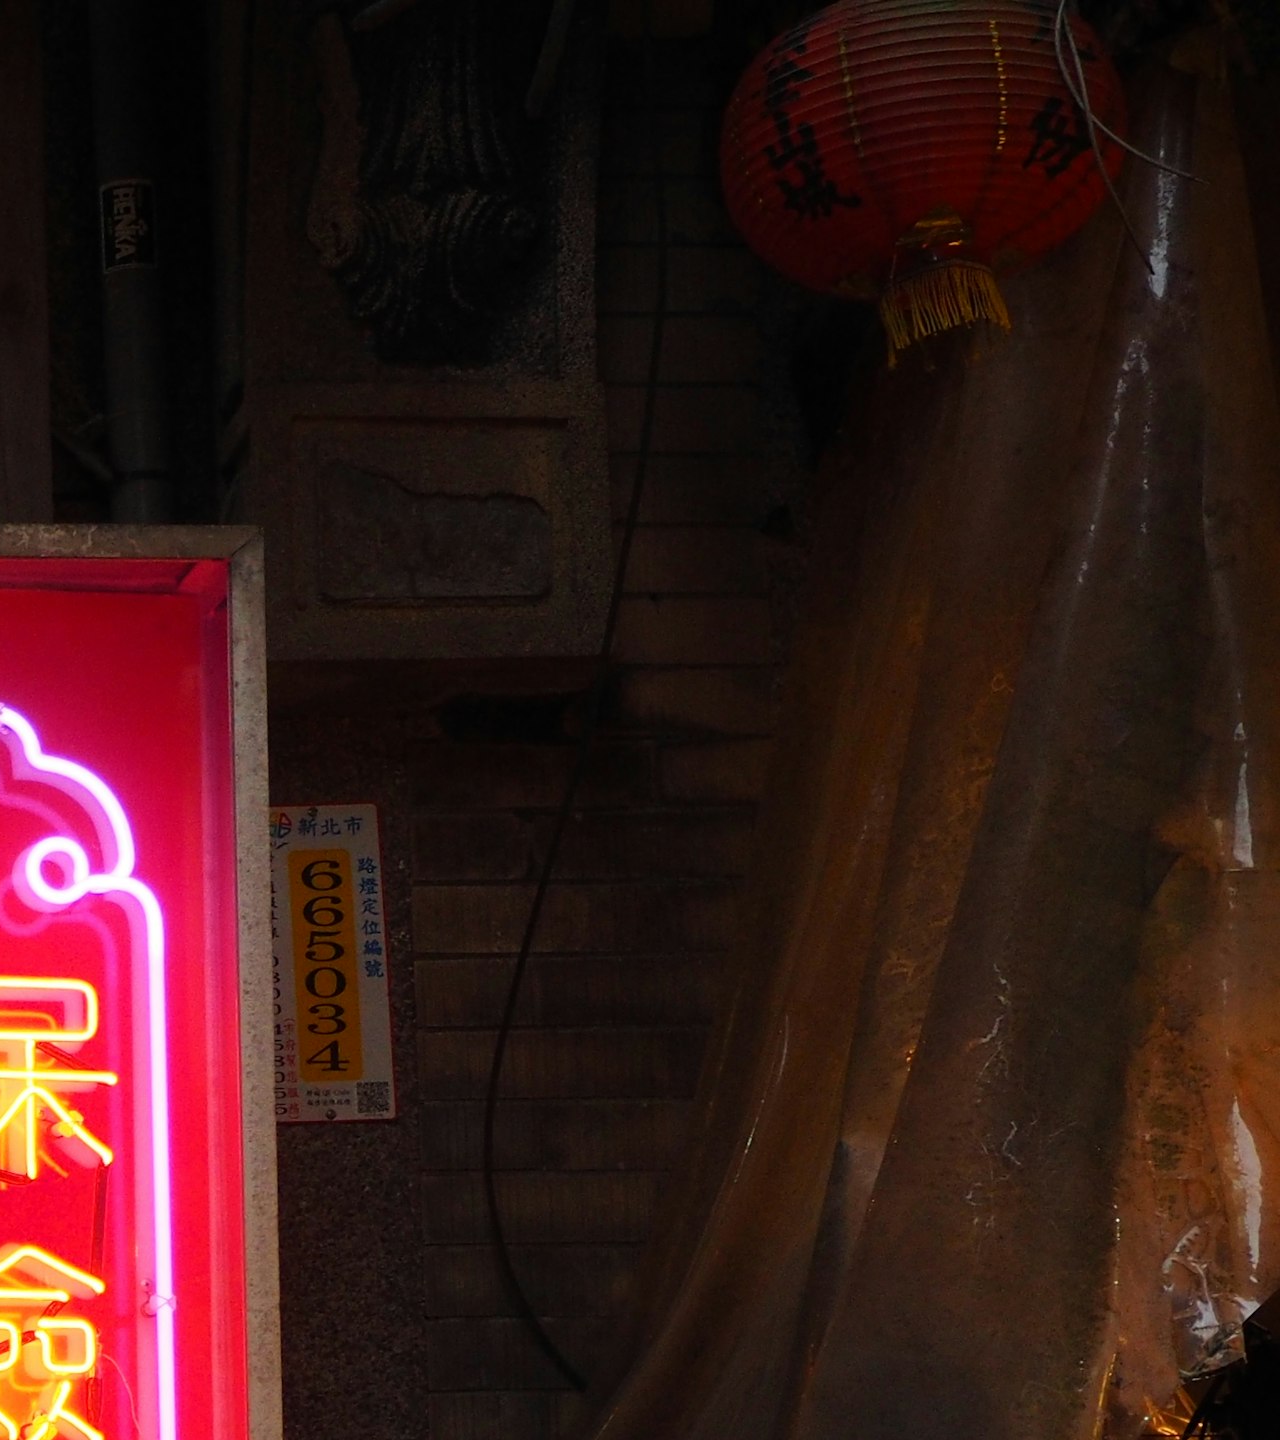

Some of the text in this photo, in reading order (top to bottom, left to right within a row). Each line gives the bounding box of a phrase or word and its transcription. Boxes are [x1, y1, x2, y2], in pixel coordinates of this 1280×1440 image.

[298, 816, 363, 837] 新北市
[301, 860, 350, 1071] 665034
[358, 857, 385, 978] 路燈定位編號
